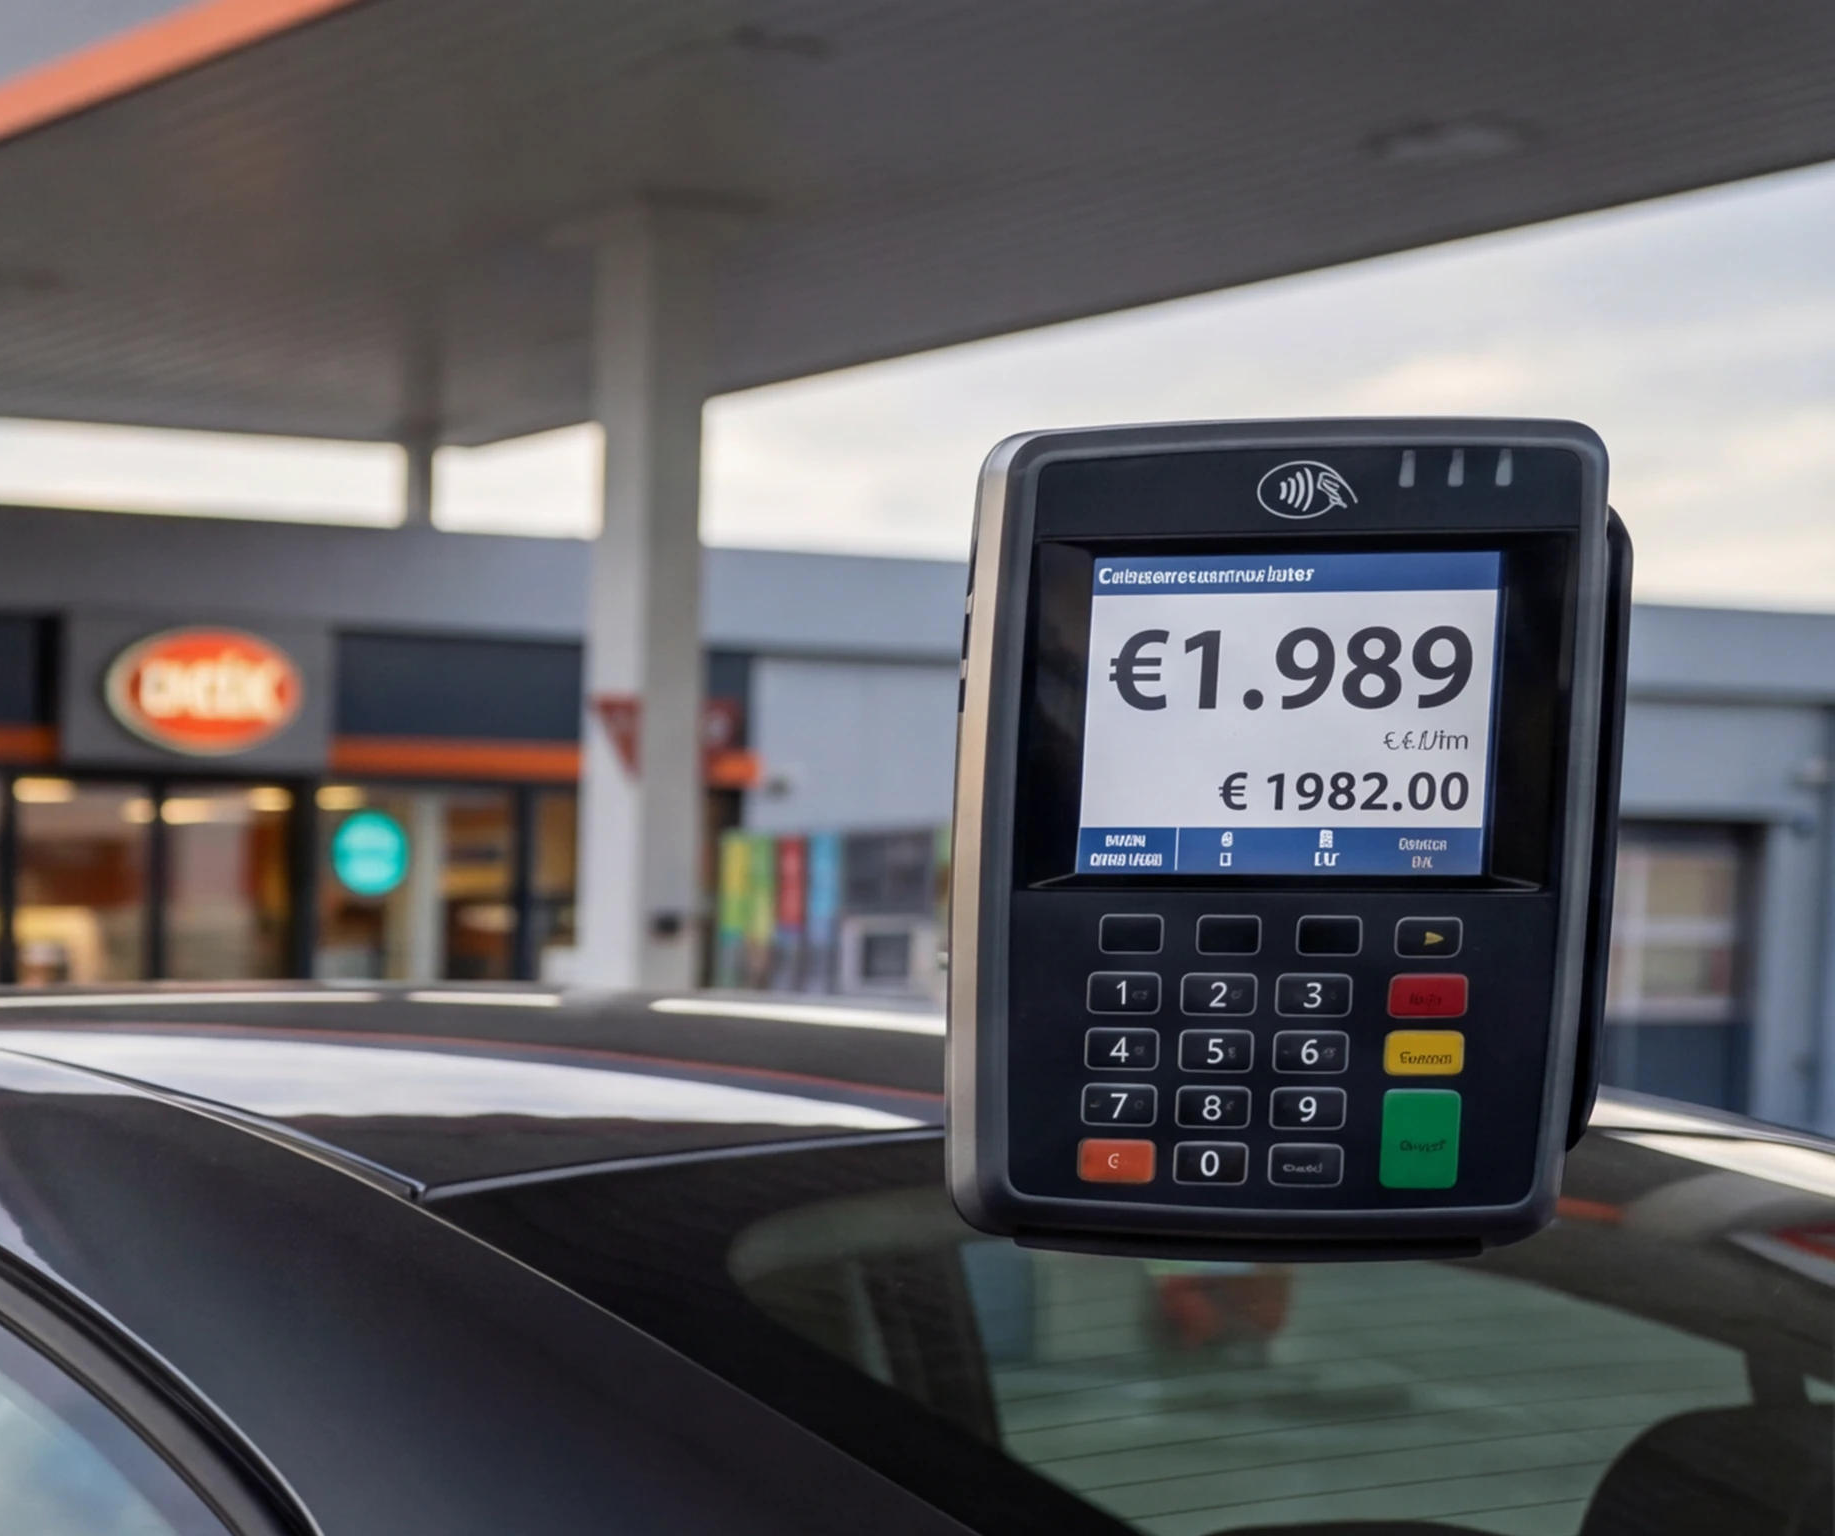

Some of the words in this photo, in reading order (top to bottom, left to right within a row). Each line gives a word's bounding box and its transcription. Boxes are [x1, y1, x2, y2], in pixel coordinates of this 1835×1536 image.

[1109, 625, 1473, 711] €1.989
[1218, 772, 1248, 811] €
[1267, 771, 1469, 812] 1982.00
[1117, 981, 1128, 1005] 1
[1209, 982, 1228, 1008] 2
[1303, 983, 1323, 1009] 3
[1109, 1037, 1130, 1063] 4
[1206, 1038, 1224, 1064] 5
[1300, 1038, 1319, 1065] 6
[1110, 1093, 1129, 1119] 7
[1202, 1094, 1222, 1121] 8
[1298, 1096, 1317, 1122] 9
[1200, 1150, 1220, 1177] 0
